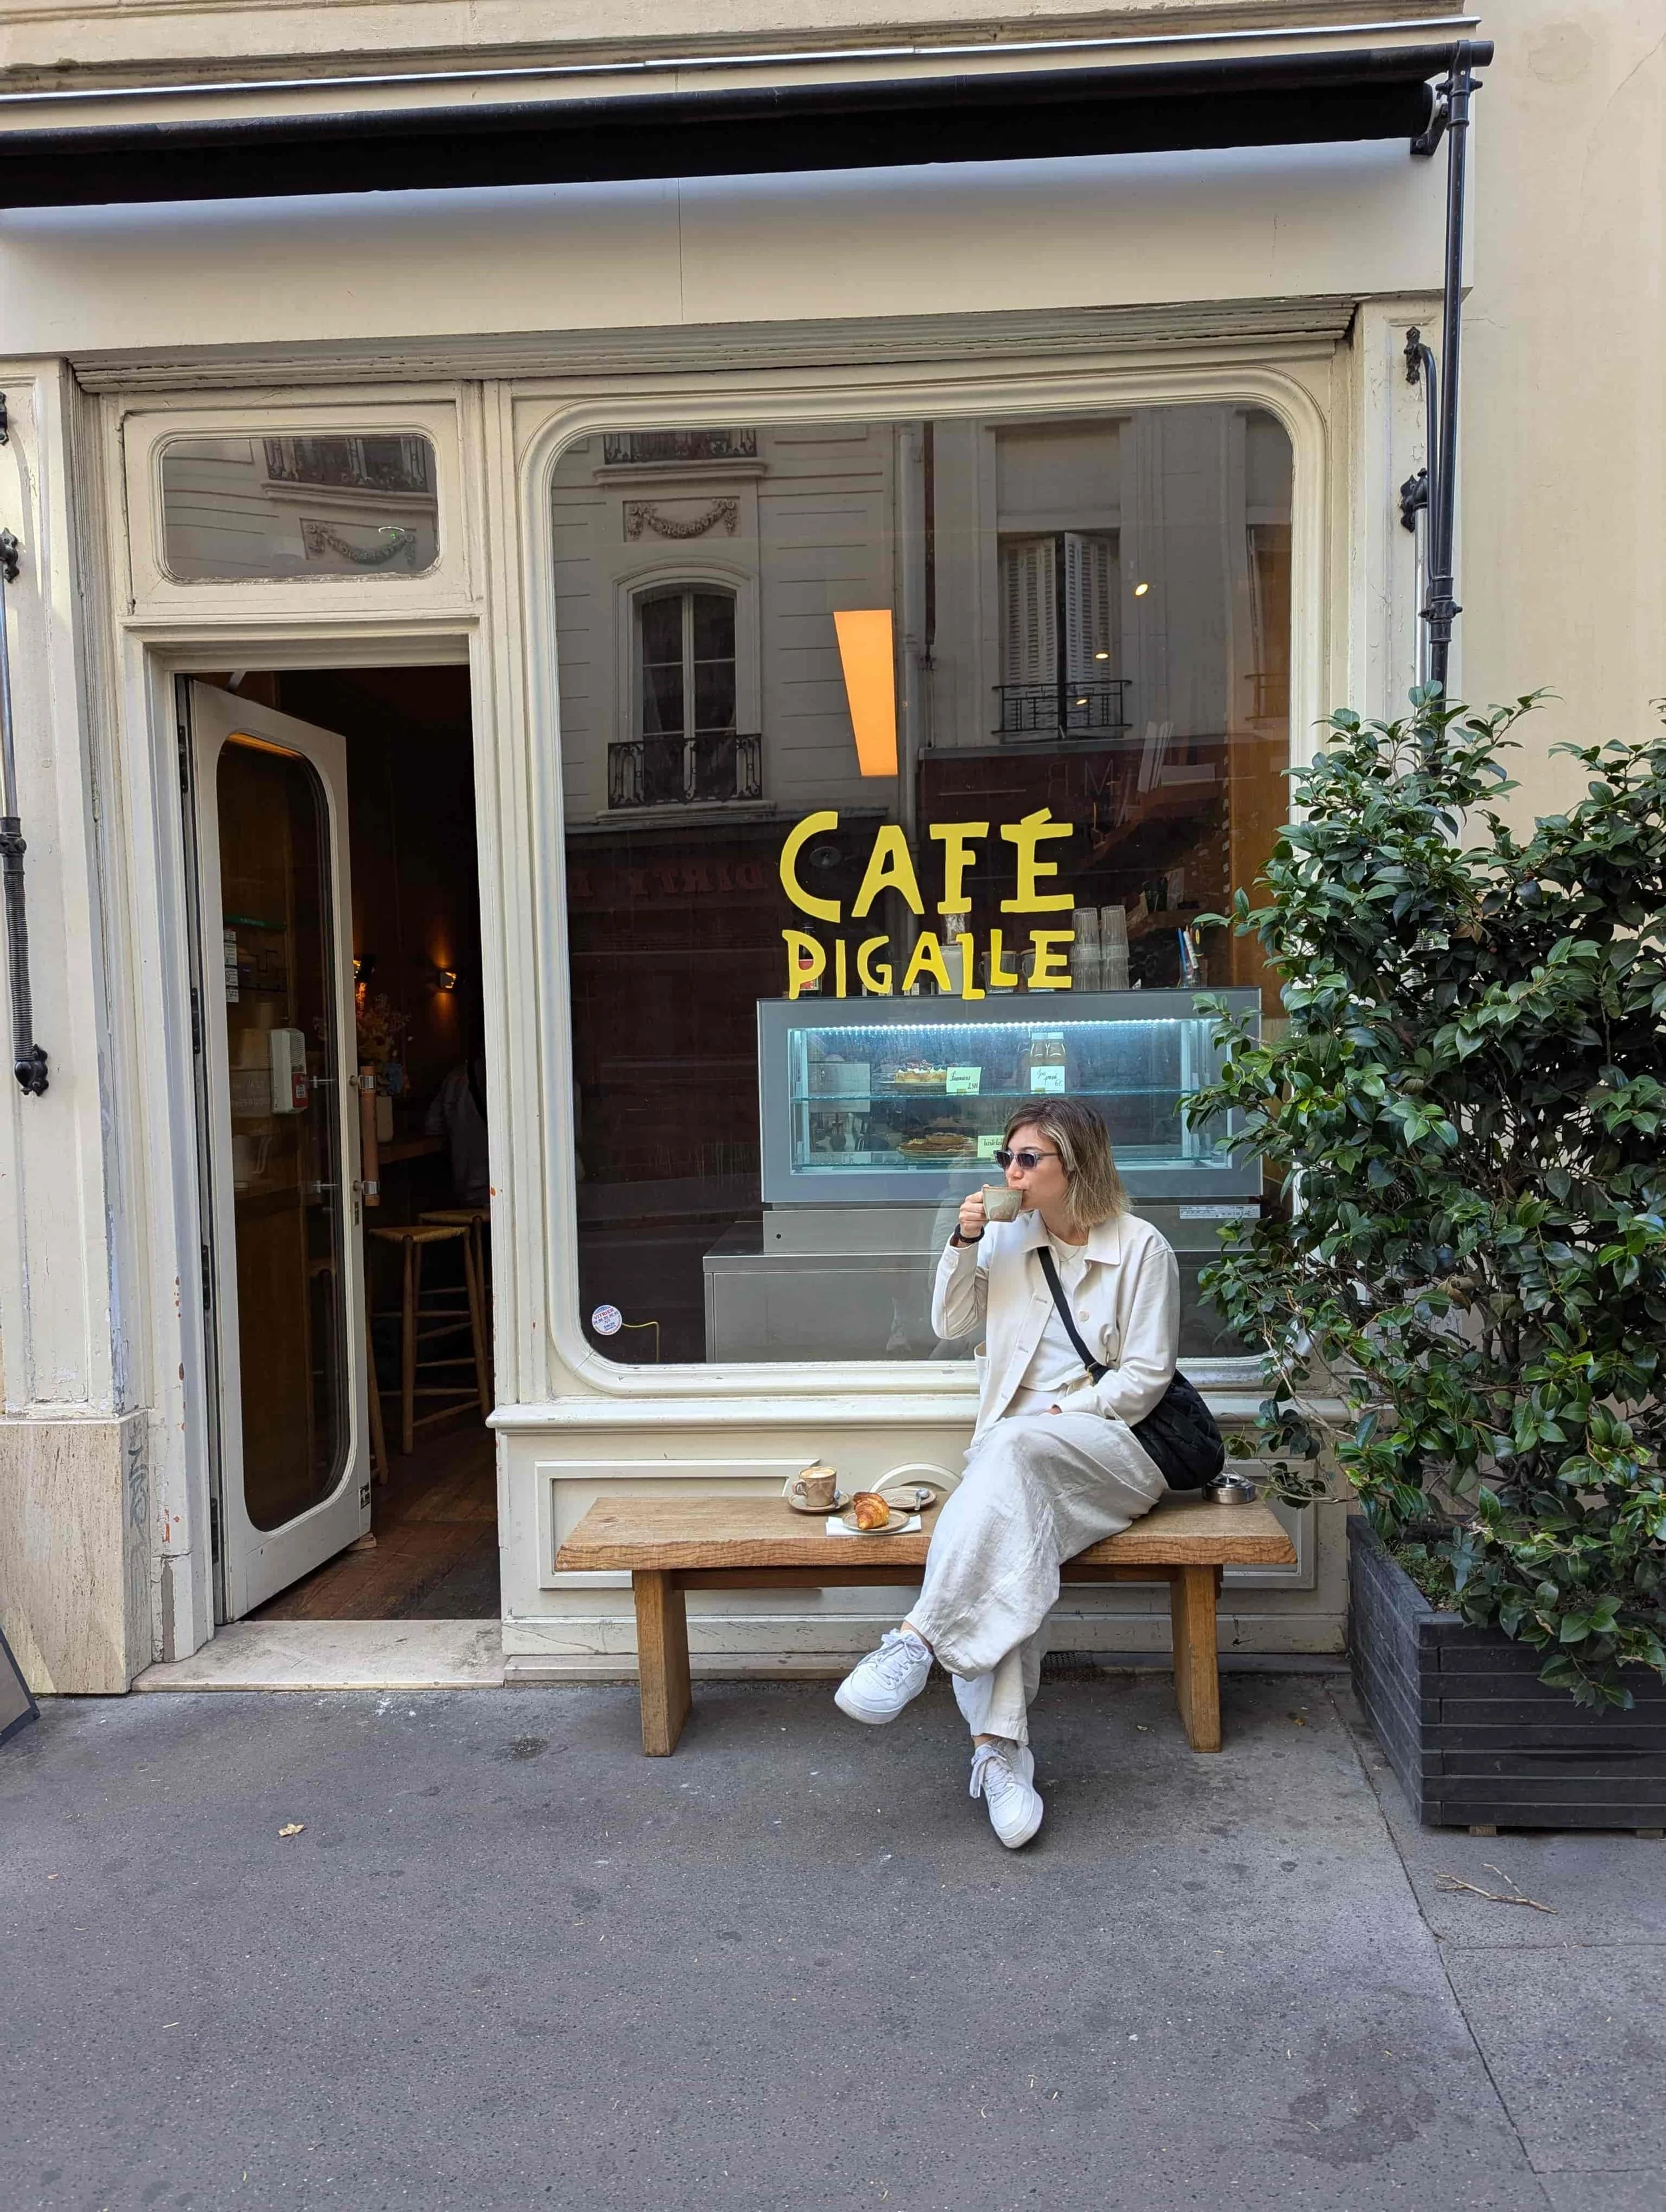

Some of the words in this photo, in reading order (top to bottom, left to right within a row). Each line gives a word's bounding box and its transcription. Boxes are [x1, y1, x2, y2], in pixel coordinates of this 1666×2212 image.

[780, 808, 1075, 922] CAFÉ
[782, 929, 1075, 1000] PIGALLE
[594, 1307, 614, 1320] VITRIER
